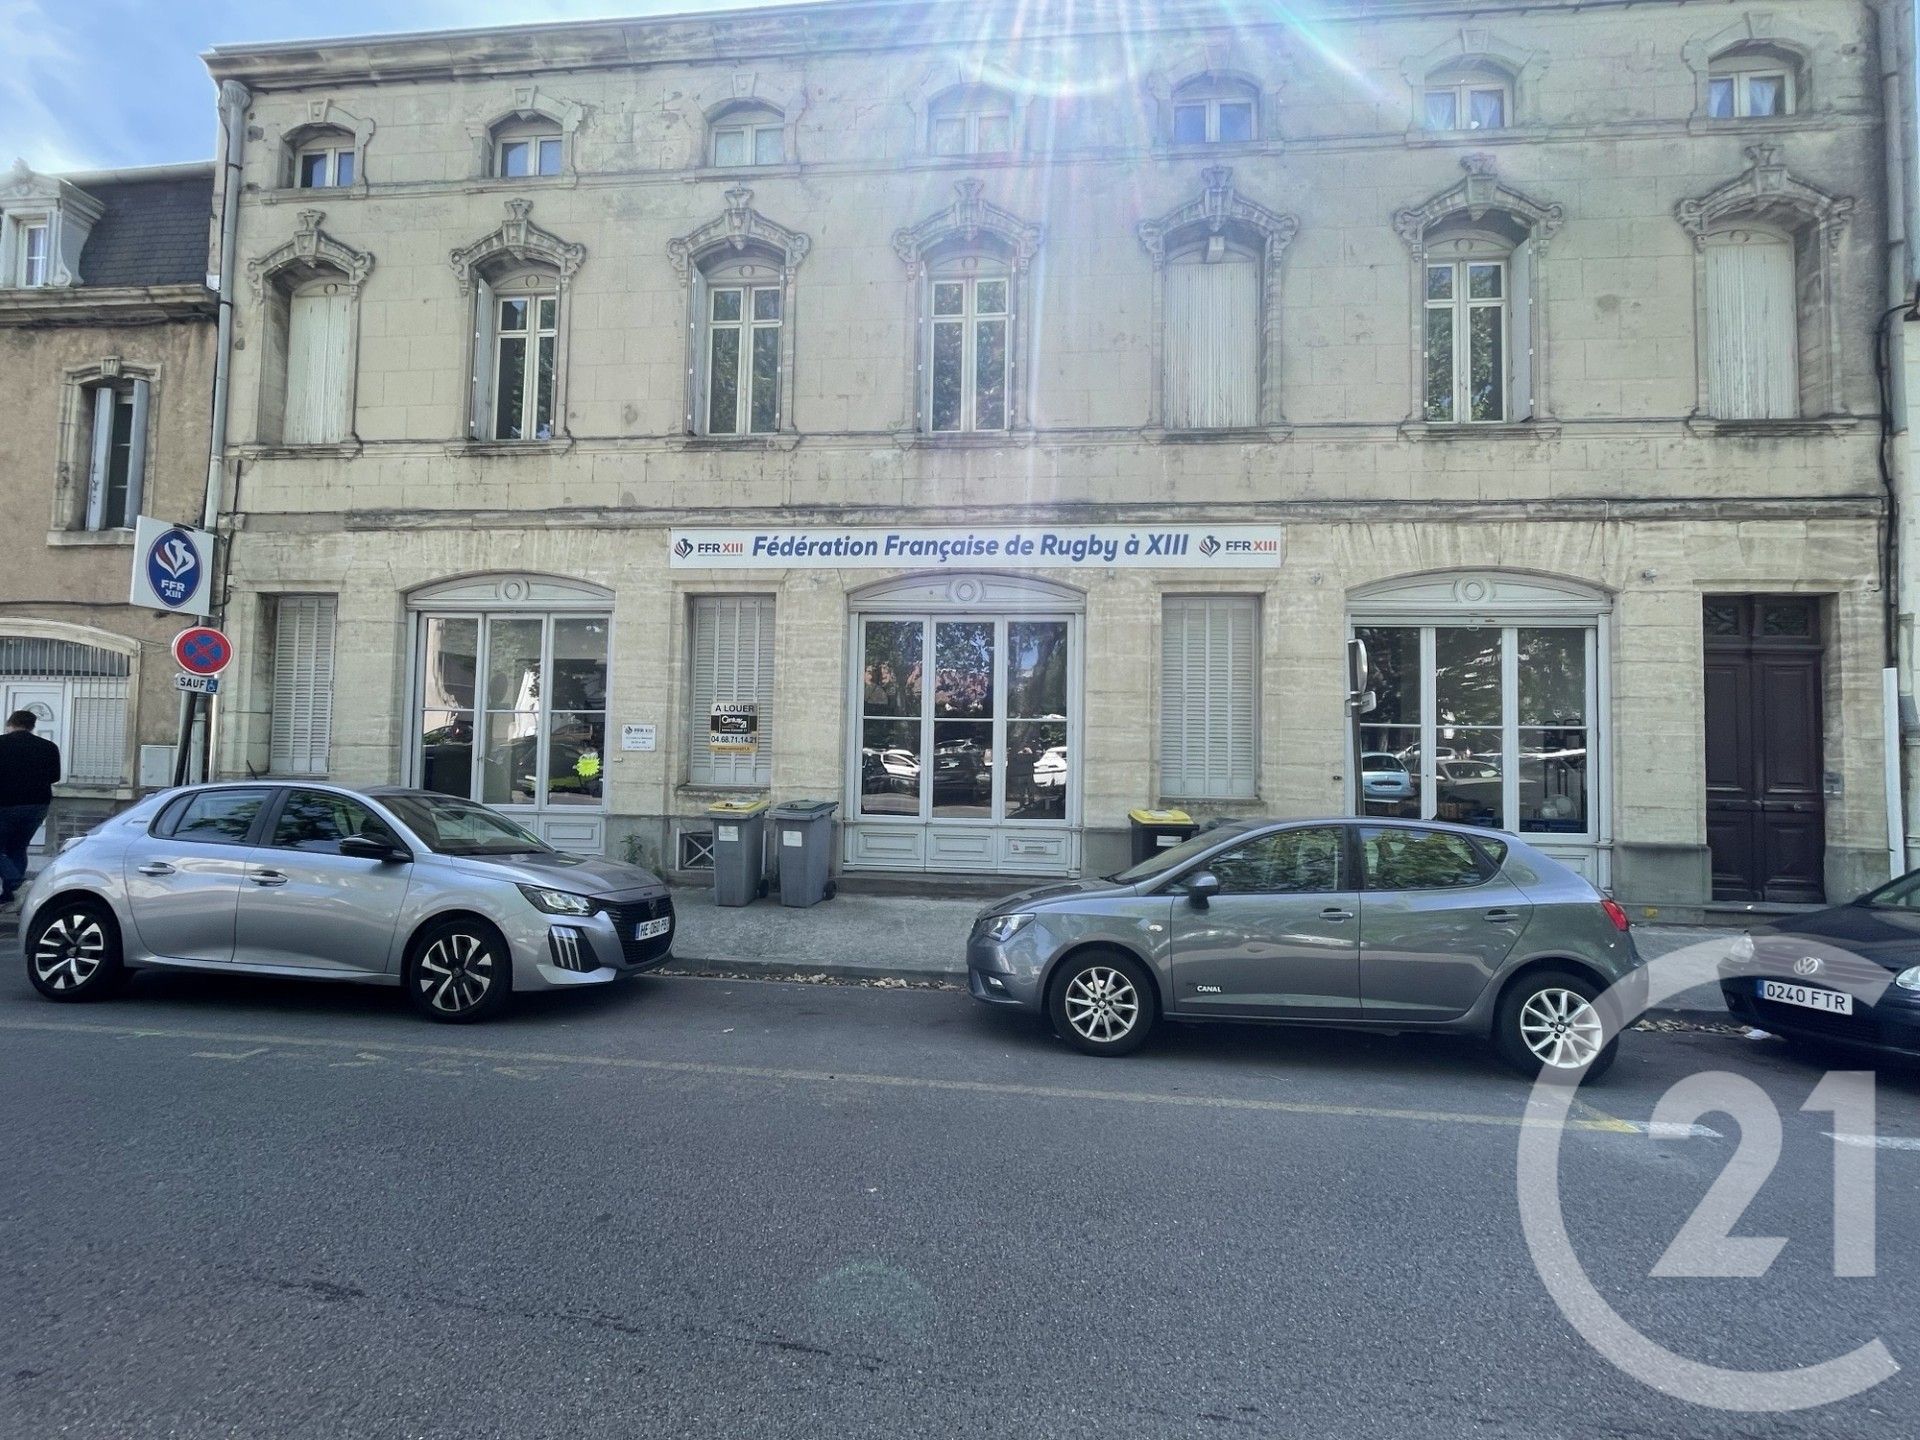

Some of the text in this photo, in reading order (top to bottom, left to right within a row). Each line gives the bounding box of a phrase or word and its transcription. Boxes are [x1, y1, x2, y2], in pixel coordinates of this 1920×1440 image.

[698, 543, 743, 553] FFR XIII
[752, 533, 1189, 562] Fédération Française de Rugby à XIII
[1226, 541, 1277, 551] FFR XIII
[161, 579, 185, 592] FFR
[164, 589, 181, 599] XIII
[180, 677, 206, 689] SAUF
[715, 704, 755, 713] A LOUER
[1196, 985, 1222, 993] CANAL
[1766, 983, 1846, 1011] 0240 FTR
